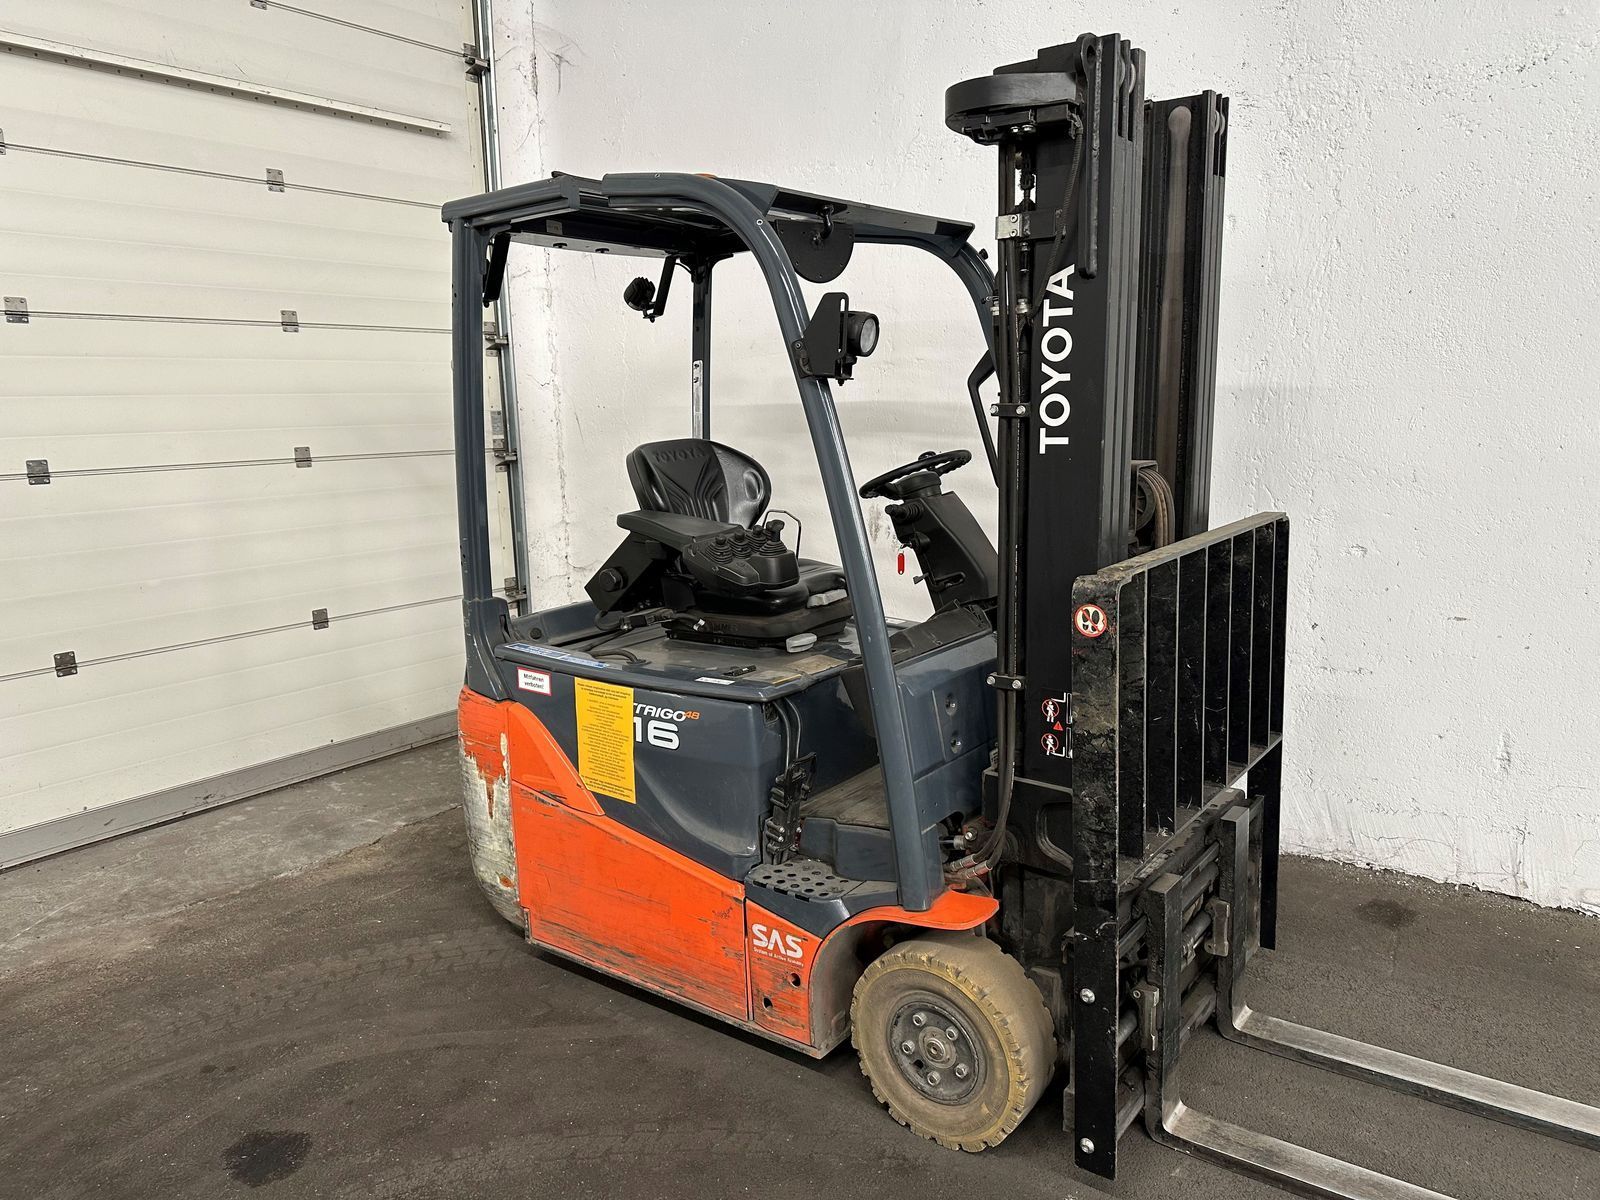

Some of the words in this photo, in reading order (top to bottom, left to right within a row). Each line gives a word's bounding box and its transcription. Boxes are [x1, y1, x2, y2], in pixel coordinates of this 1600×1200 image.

[1039, 264, 1075, 454] TOYOTA
[523, 673, 544, 683] Mitfahren
[633, 716, 680, 750] 16
[752, 923, 803, 959] SAS
